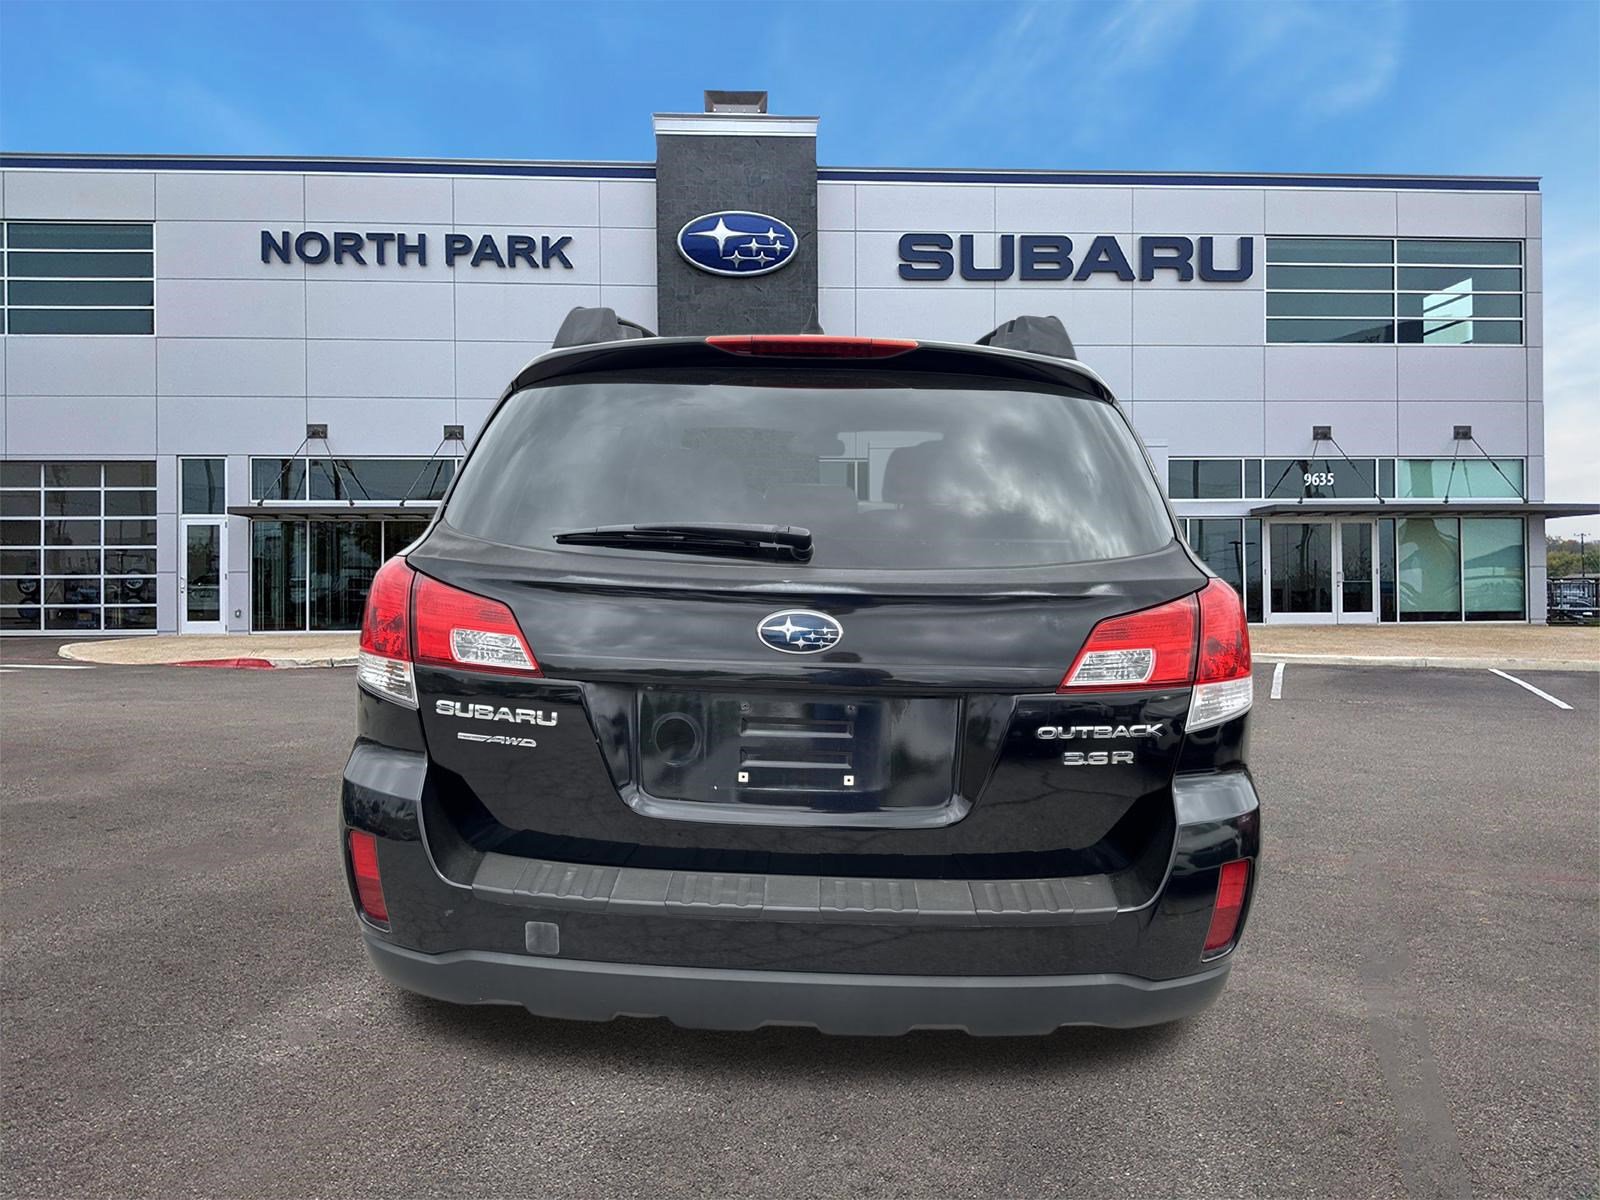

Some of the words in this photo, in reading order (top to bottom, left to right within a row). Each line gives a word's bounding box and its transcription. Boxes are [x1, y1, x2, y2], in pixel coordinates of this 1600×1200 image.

[260, 230, 427, 266] NORTH
[444, 233, 574, 269] PARK
[898, 233, 1254, 282] SUBARU
[1303, 472, 1335, 486] 9635
[435, 700, 558, 726] SUBARU
[486, 735, 537, 747] AWD
[1037, 723, 1164, 739] OUTBACK
